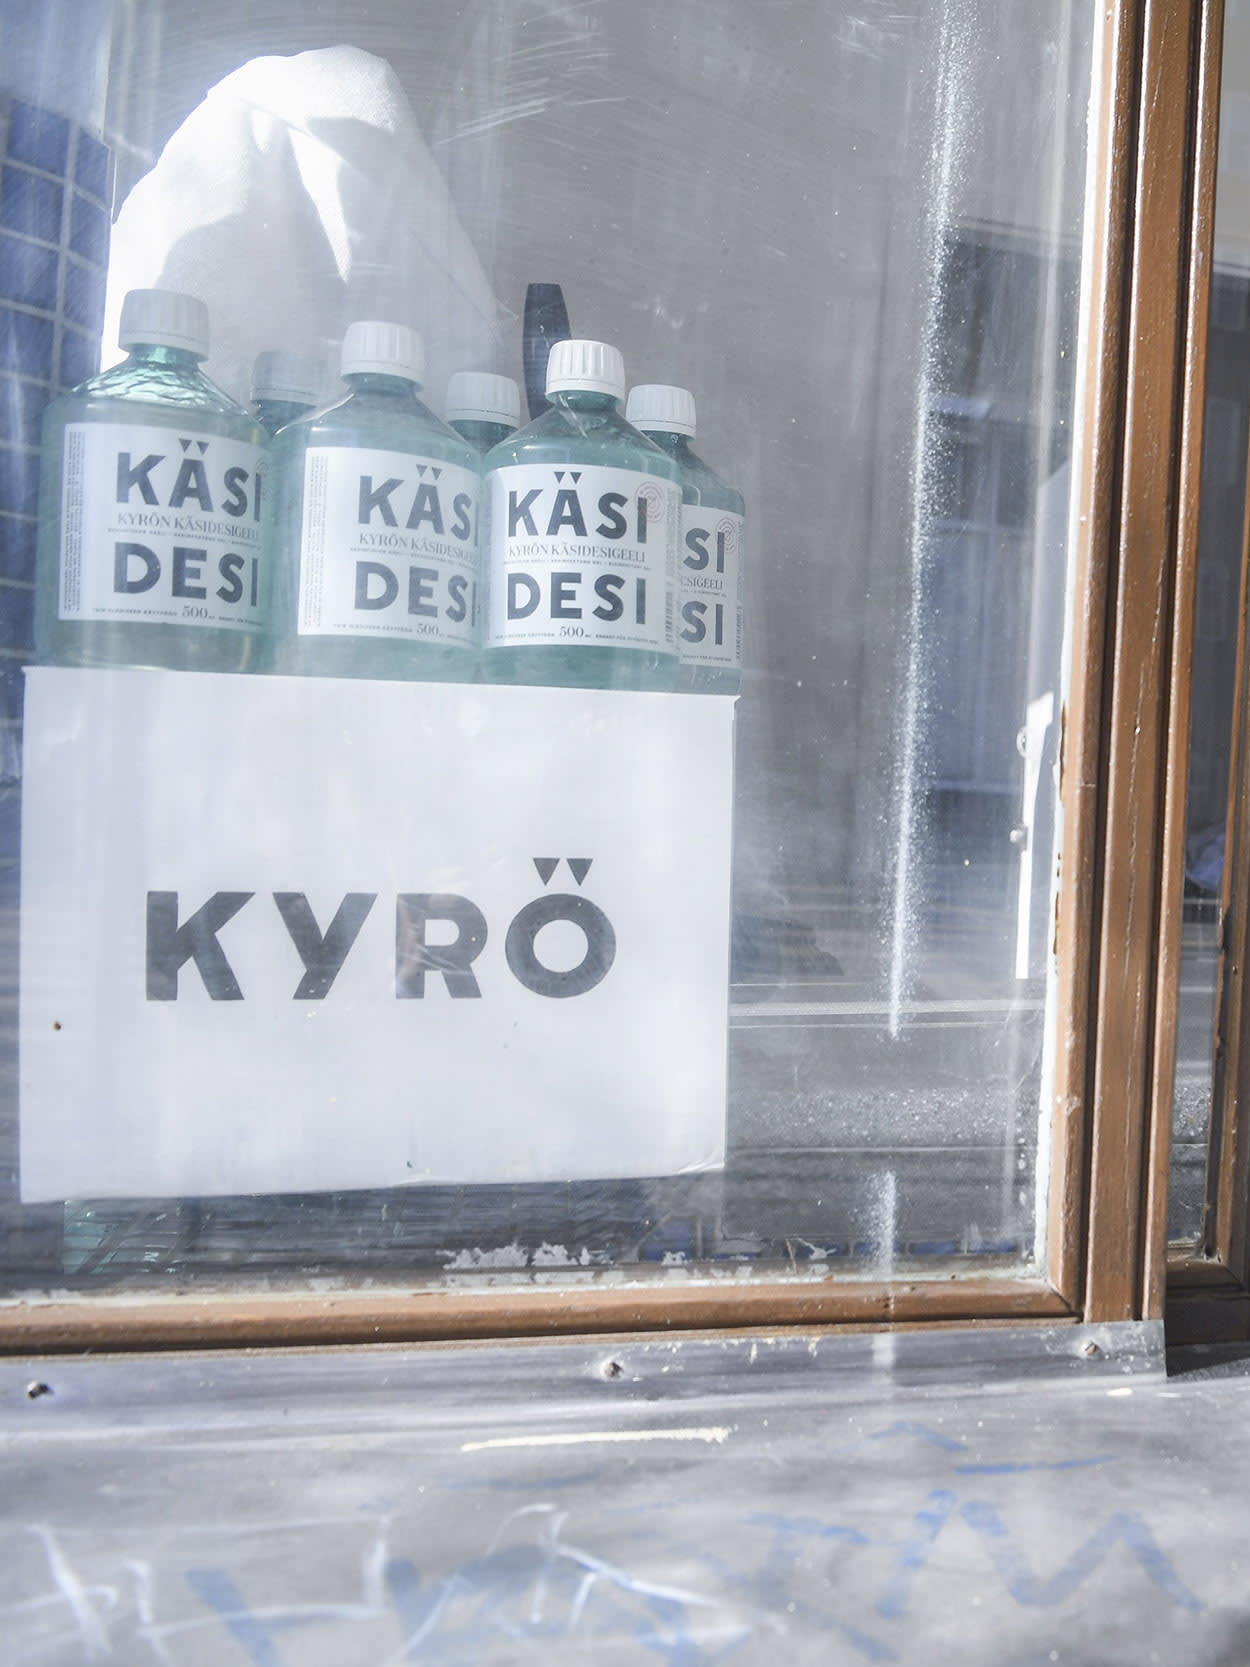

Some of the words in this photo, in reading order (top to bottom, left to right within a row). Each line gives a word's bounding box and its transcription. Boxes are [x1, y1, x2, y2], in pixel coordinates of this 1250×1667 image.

[116, 438, 262, 522] KÄSI
[118, 511, 170, 529] KYRÖN
[508, 471, 648, 544] KÄSI
[359, 532, 408, 549] KYRÖN
[508, 542, 549, 558] KYRÖN
[551, 542, 646, 563] KÄSIDESIGEELI
[683, 527, 725, 574] SI
[113, 541, 258, 608] DESI
[182, 606, 209, 620] 500
[507, 571, 646, 625] DESI
[416, 623, 439, 636] 500
[559, 626, 585, 638] 500
[680, 600, 724, 646] SI
[145, 857, 617, 1001] KYRÖ
